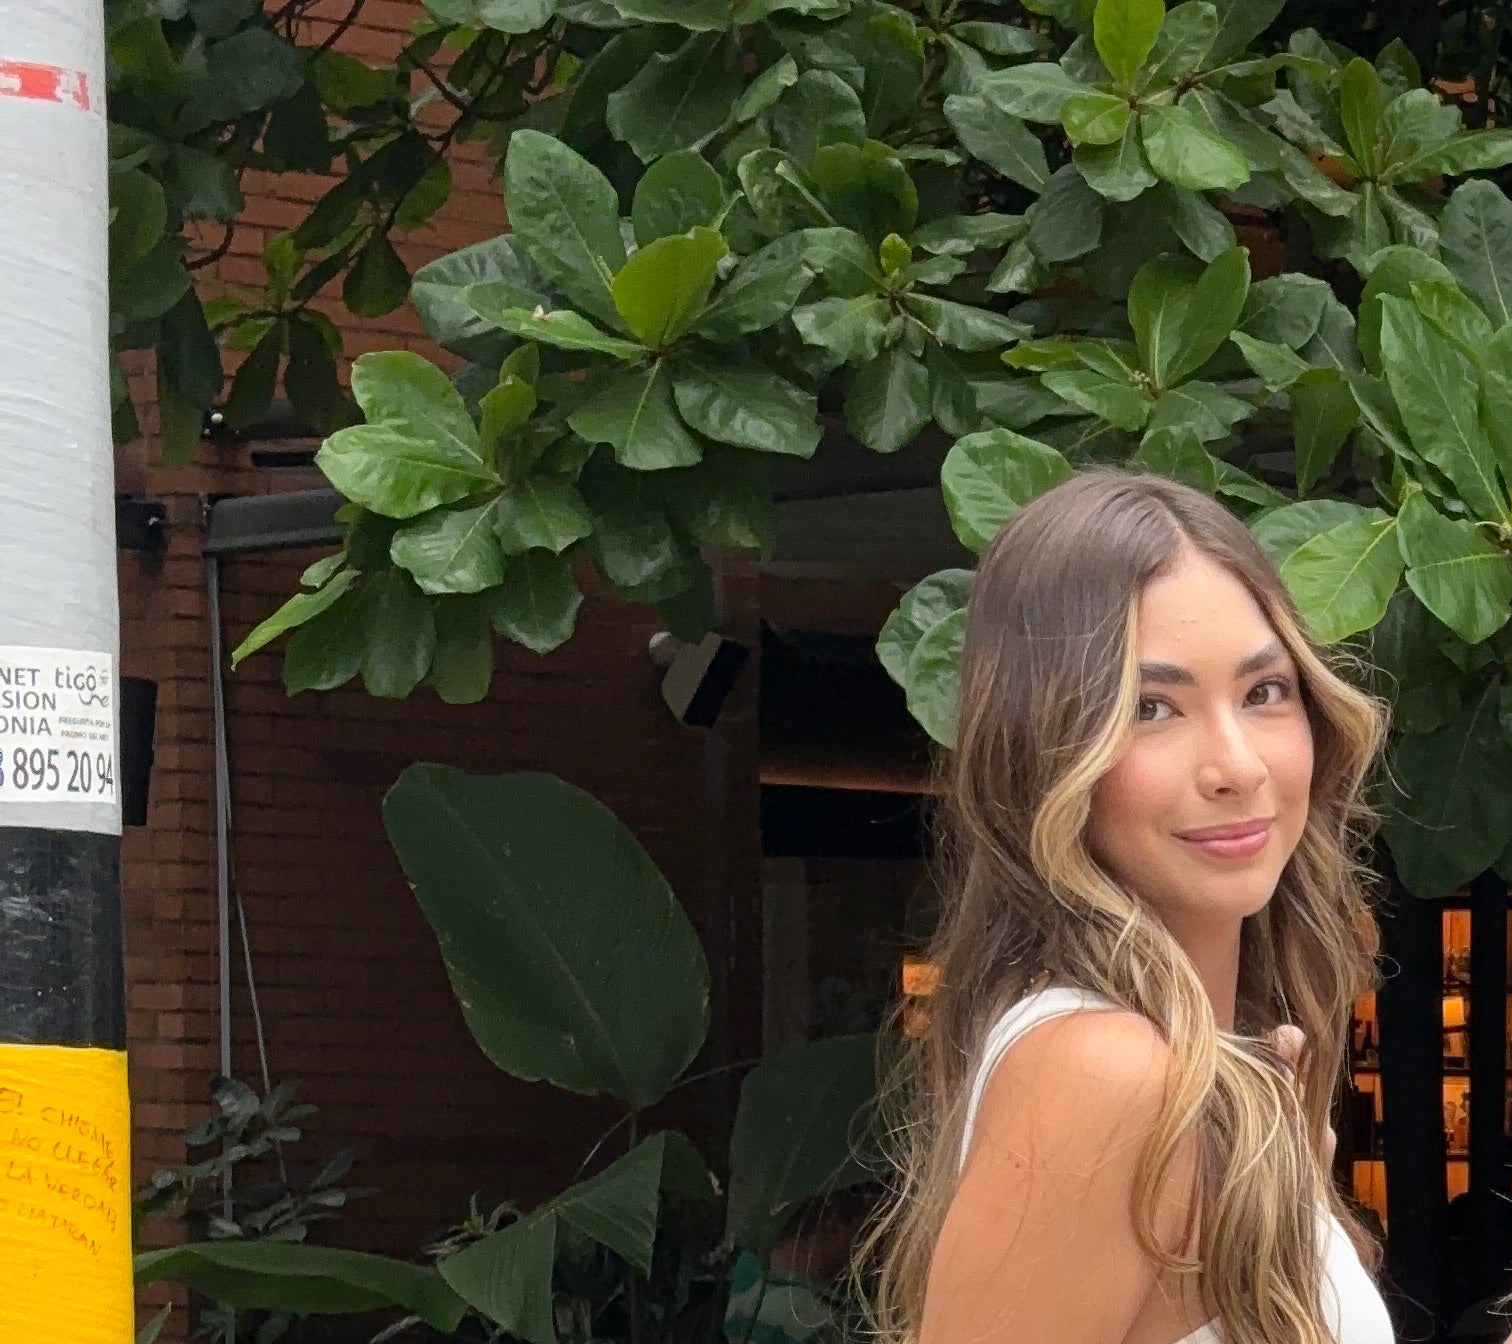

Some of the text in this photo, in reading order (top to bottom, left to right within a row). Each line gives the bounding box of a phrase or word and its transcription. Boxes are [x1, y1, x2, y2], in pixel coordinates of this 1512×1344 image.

[12, 747, 60, 791] 895
[66, 750, 92, 793] 20
[96, 752, 114, 796] 94
